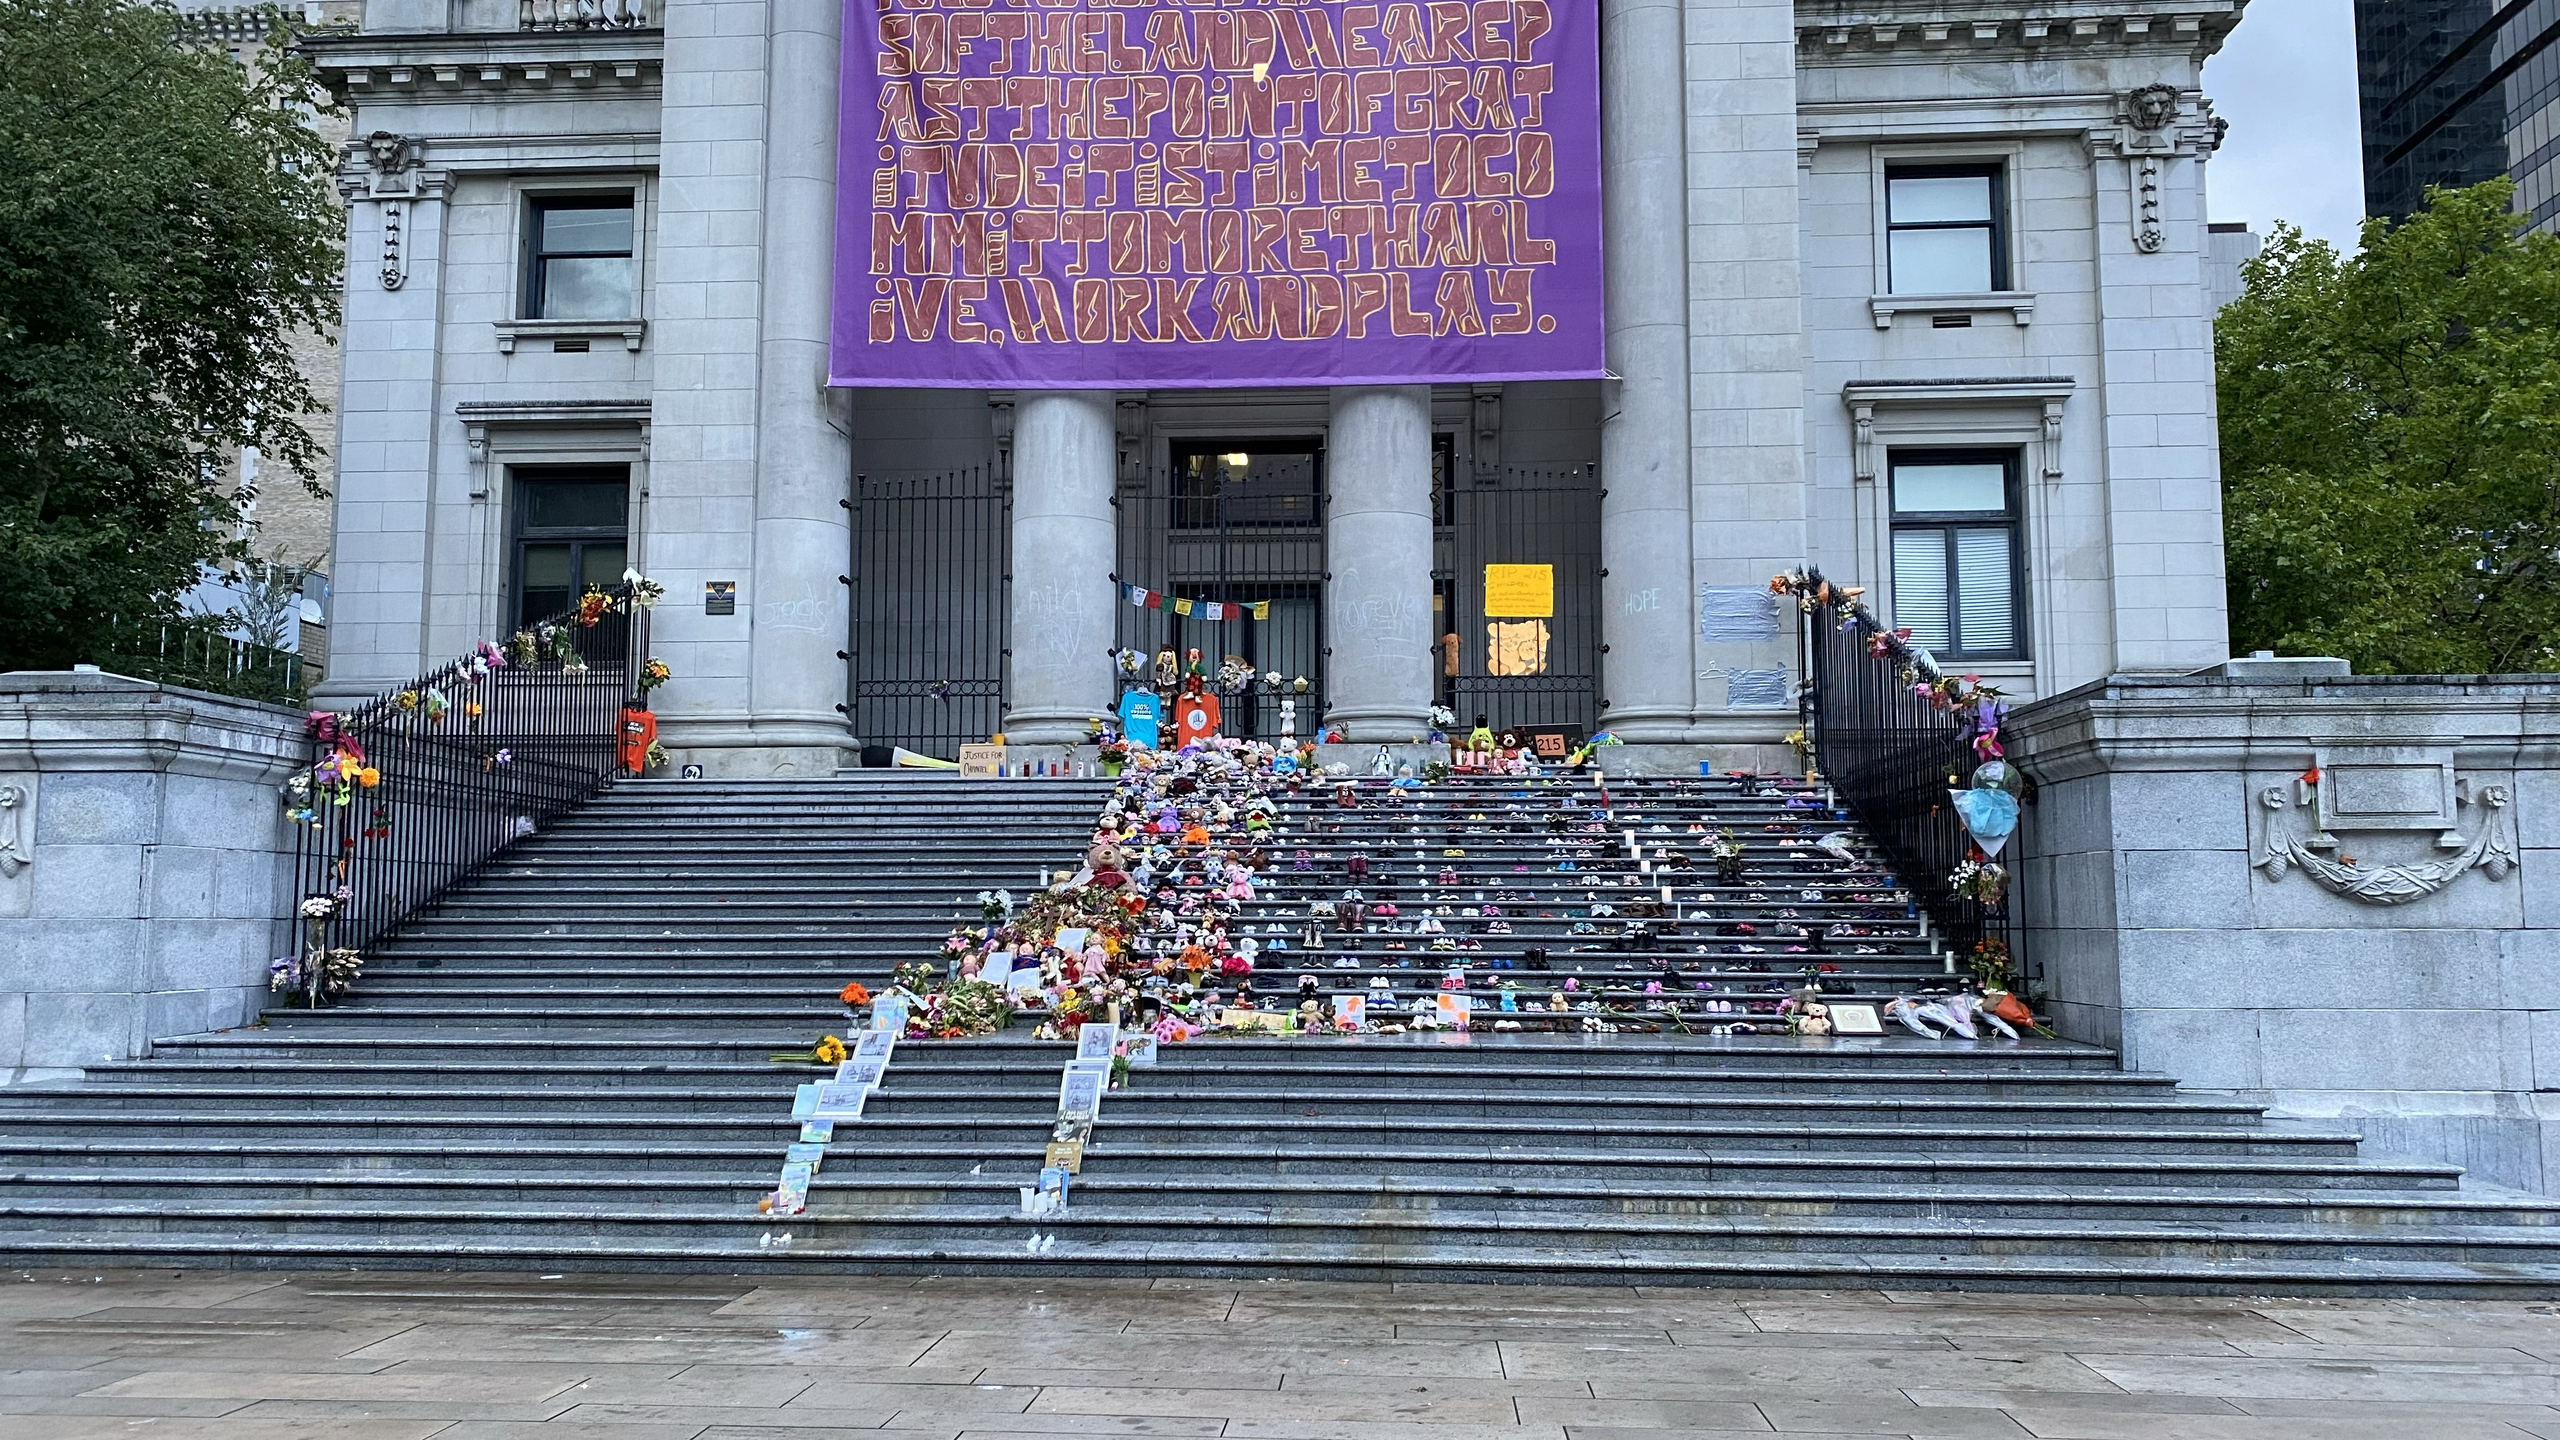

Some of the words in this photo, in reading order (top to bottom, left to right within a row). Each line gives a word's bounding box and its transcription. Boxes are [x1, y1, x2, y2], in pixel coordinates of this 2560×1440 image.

[1490, 566, 1517, 579] RIP
[1524, 568, 1547, 580] 215
[1625, 588, 1661, 615] HOPE
[1537, 738, 1561, 751] 215
[963, 751, 989, 760] JUSTICE
[991, 751, 1003, 759] FOR
